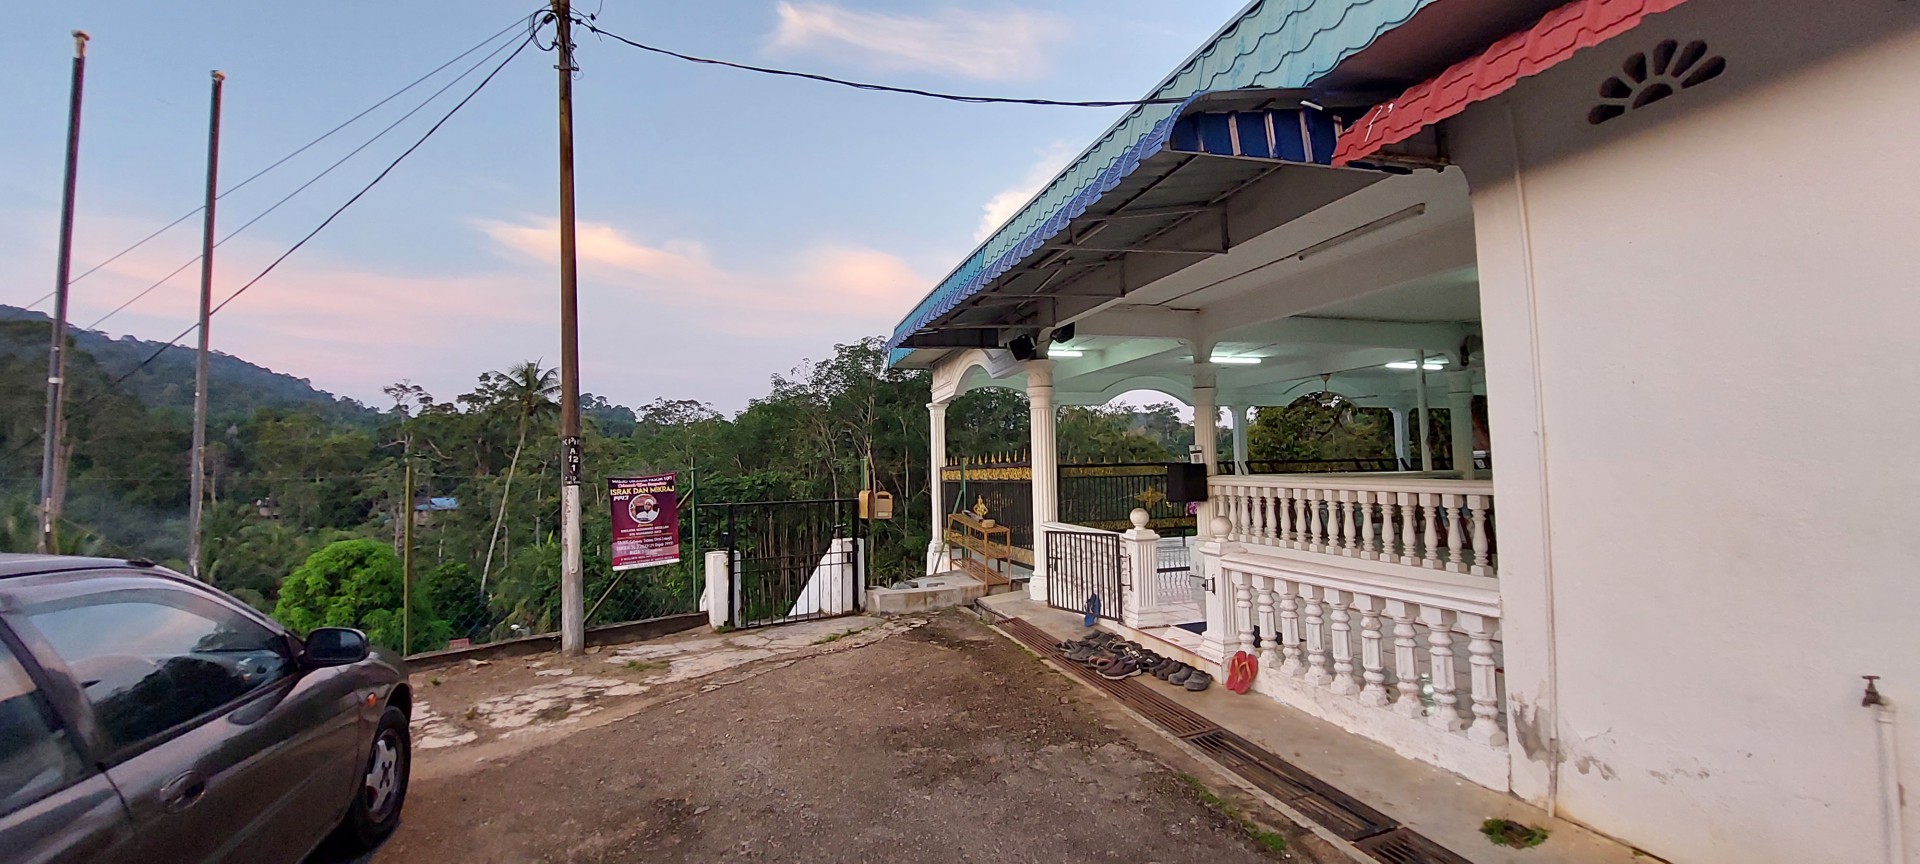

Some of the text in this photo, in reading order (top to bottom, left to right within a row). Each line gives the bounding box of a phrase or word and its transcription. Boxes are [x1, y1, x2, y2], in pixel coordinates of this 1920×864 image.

[570, 447, 576, 455] A
[568, 455, 579, 463] 12
[571, 464, 576, 472] 1
[610, 487, 632, 496] ISRAK
[633, 486, 649, 495] DAN
[650, 485, 675, 493] MIKRAJ
